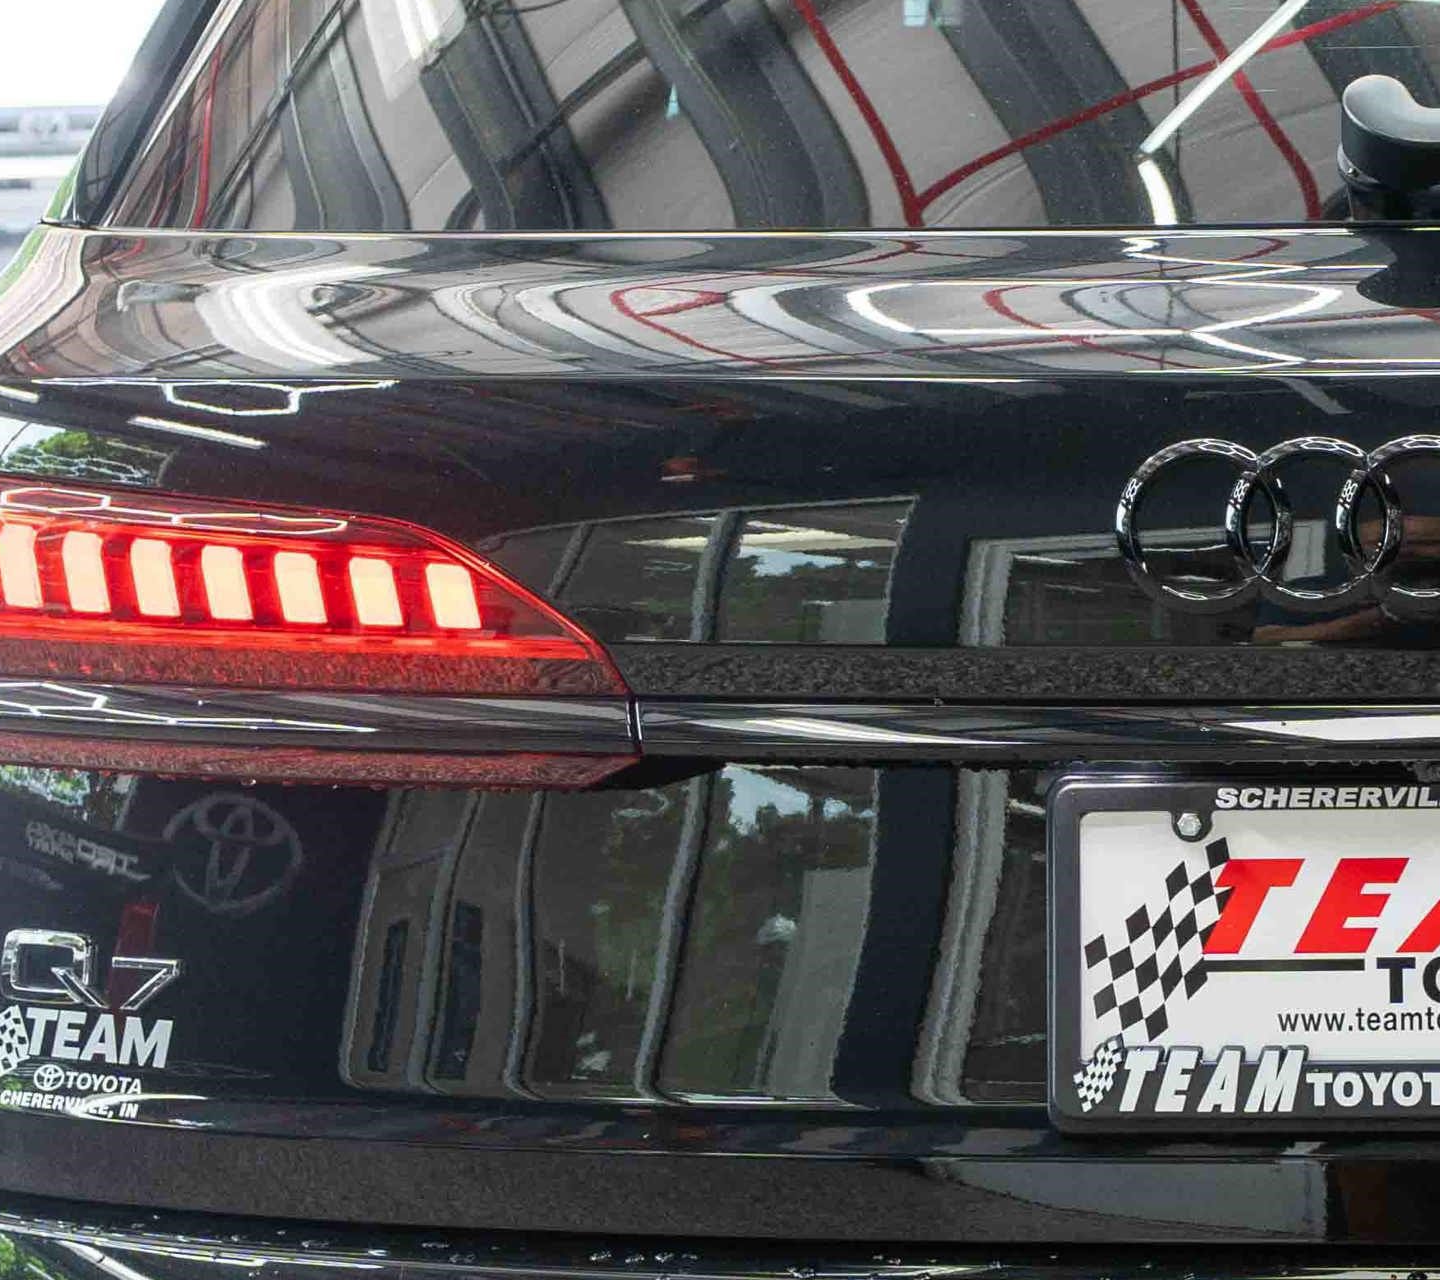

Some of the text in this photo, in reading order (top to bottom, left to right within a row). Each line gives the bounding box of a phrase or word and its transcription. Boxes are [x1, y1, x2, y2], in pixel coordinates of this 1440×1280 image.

[0, 928, 182, 1010] Q7
[25, 1007, 174, 1069] TEAM
[66, 1070, 142, 1095] TOYOTA
[119, 1102, 139, 1118] IN
[1118, 1049, 1305, 1113] TEAM
